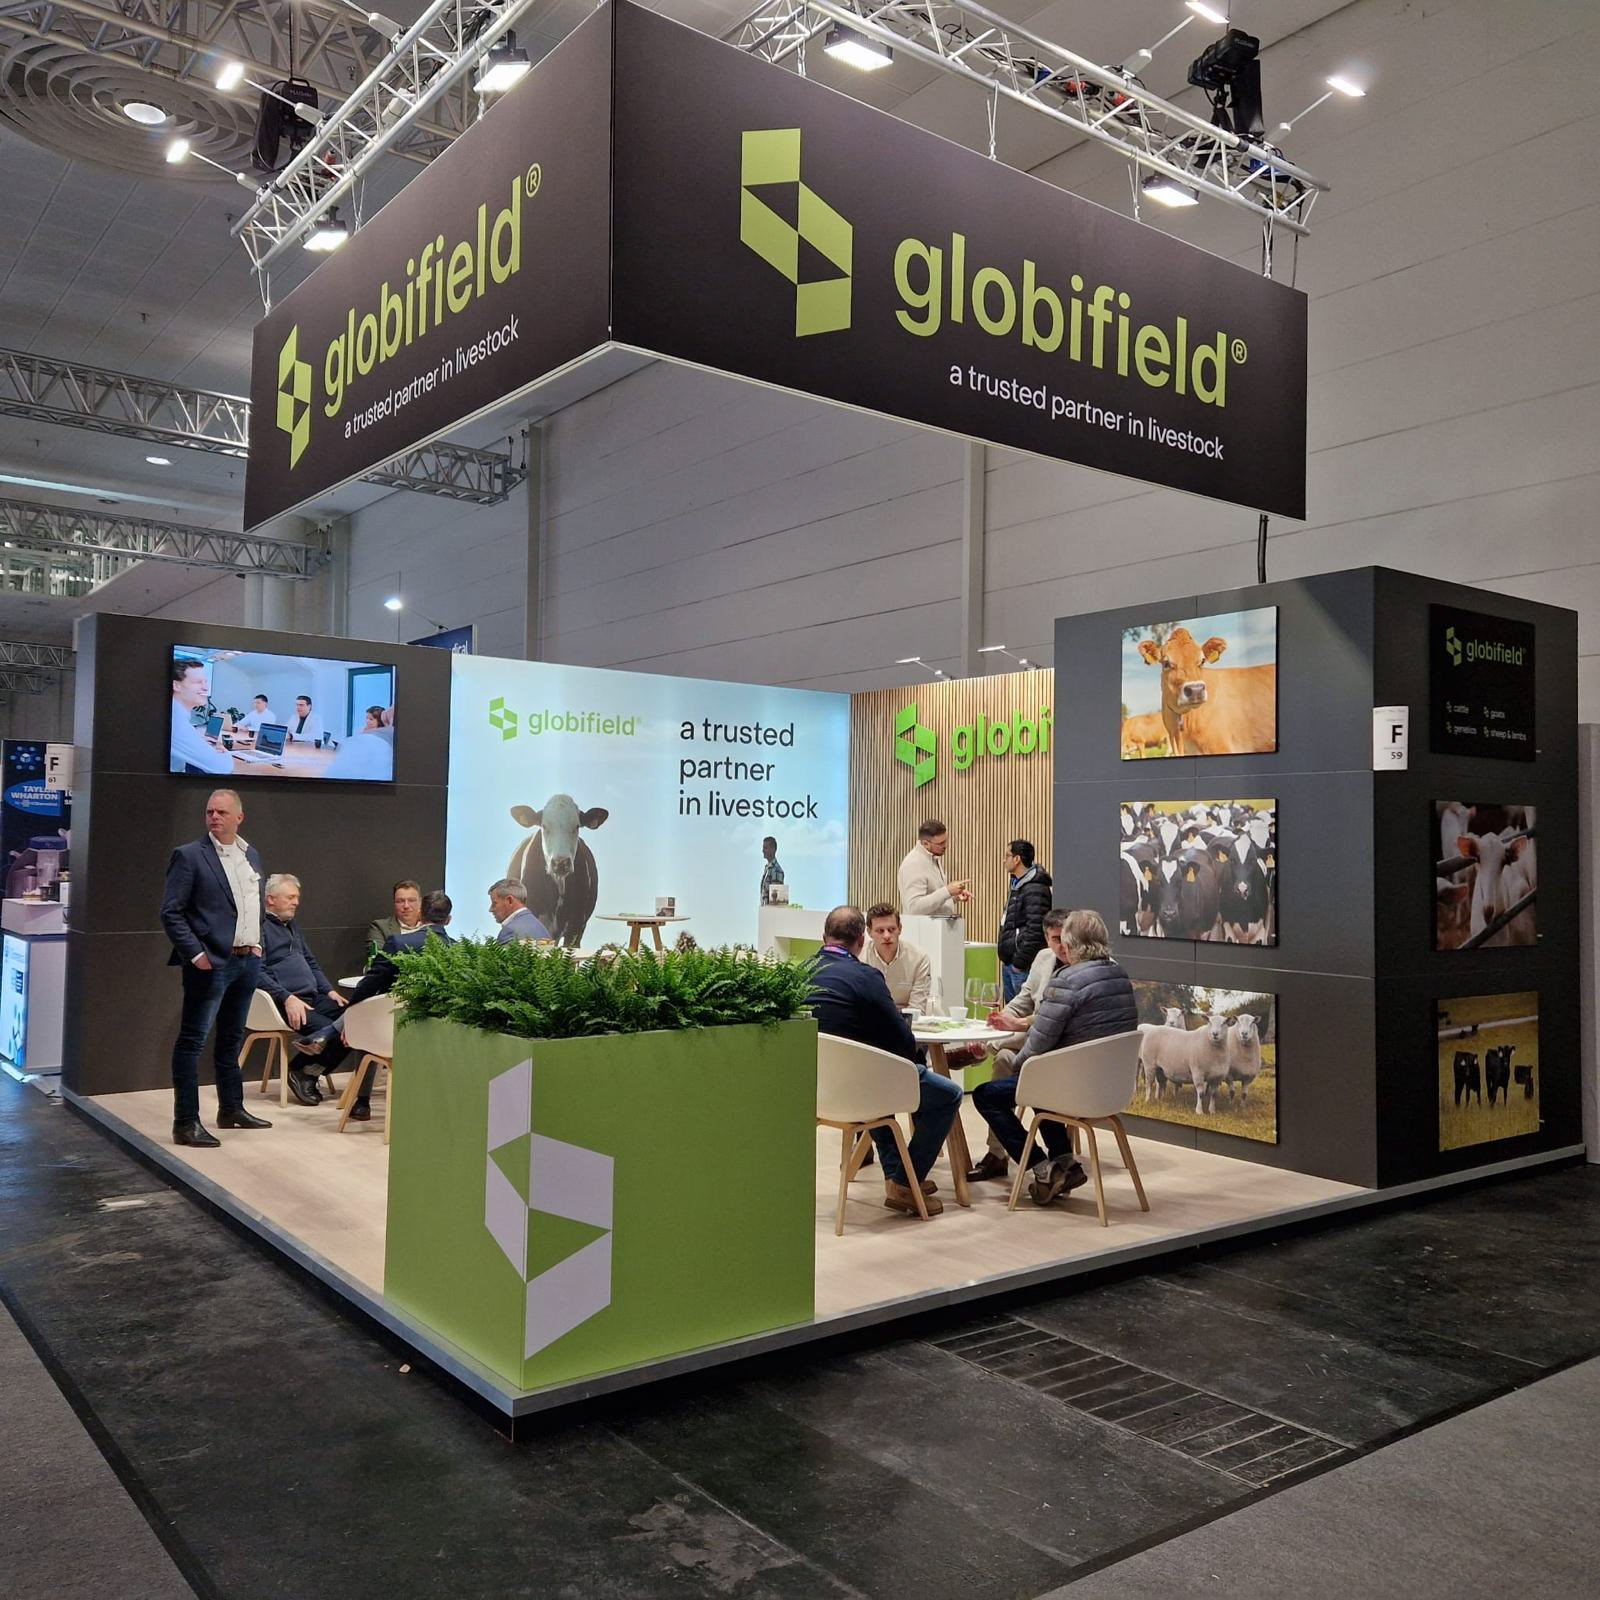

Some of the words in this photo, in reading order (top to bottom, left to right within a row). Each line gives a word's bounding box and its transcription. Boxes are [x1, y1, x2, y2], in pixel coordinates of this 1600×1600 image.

[344, 420, 351, 439] a
[353, 392, 392, 434] trusted
[394, 367, 439, 417] partner
[441, 357, 453, 382] in
[455, 313, 519, 374] livestock
[949, 365, 963, 386] a
[968, 365, 1047, 410] trusted
[1051, 394, 1124, 432] partner
[1128, 412, 1144, 438] in
[1148, 417, 1224, 461] livestock
[680, 719, 695, 741] a
[703, 717, 795, 748] trusted
[952, 705, 1055, 770] globi
[1391, 724, 1404, 744] F
[50, 756, 59, 771] F
[679, 755, 776, 785] partner
[1391, 751, 1403, 760] 59
[48, 776, 57, 784] 61
[11, 792, 58, 800] WHARTON
[678, 789, 701, 816] in
[708, 790, 819, 820] livestock
